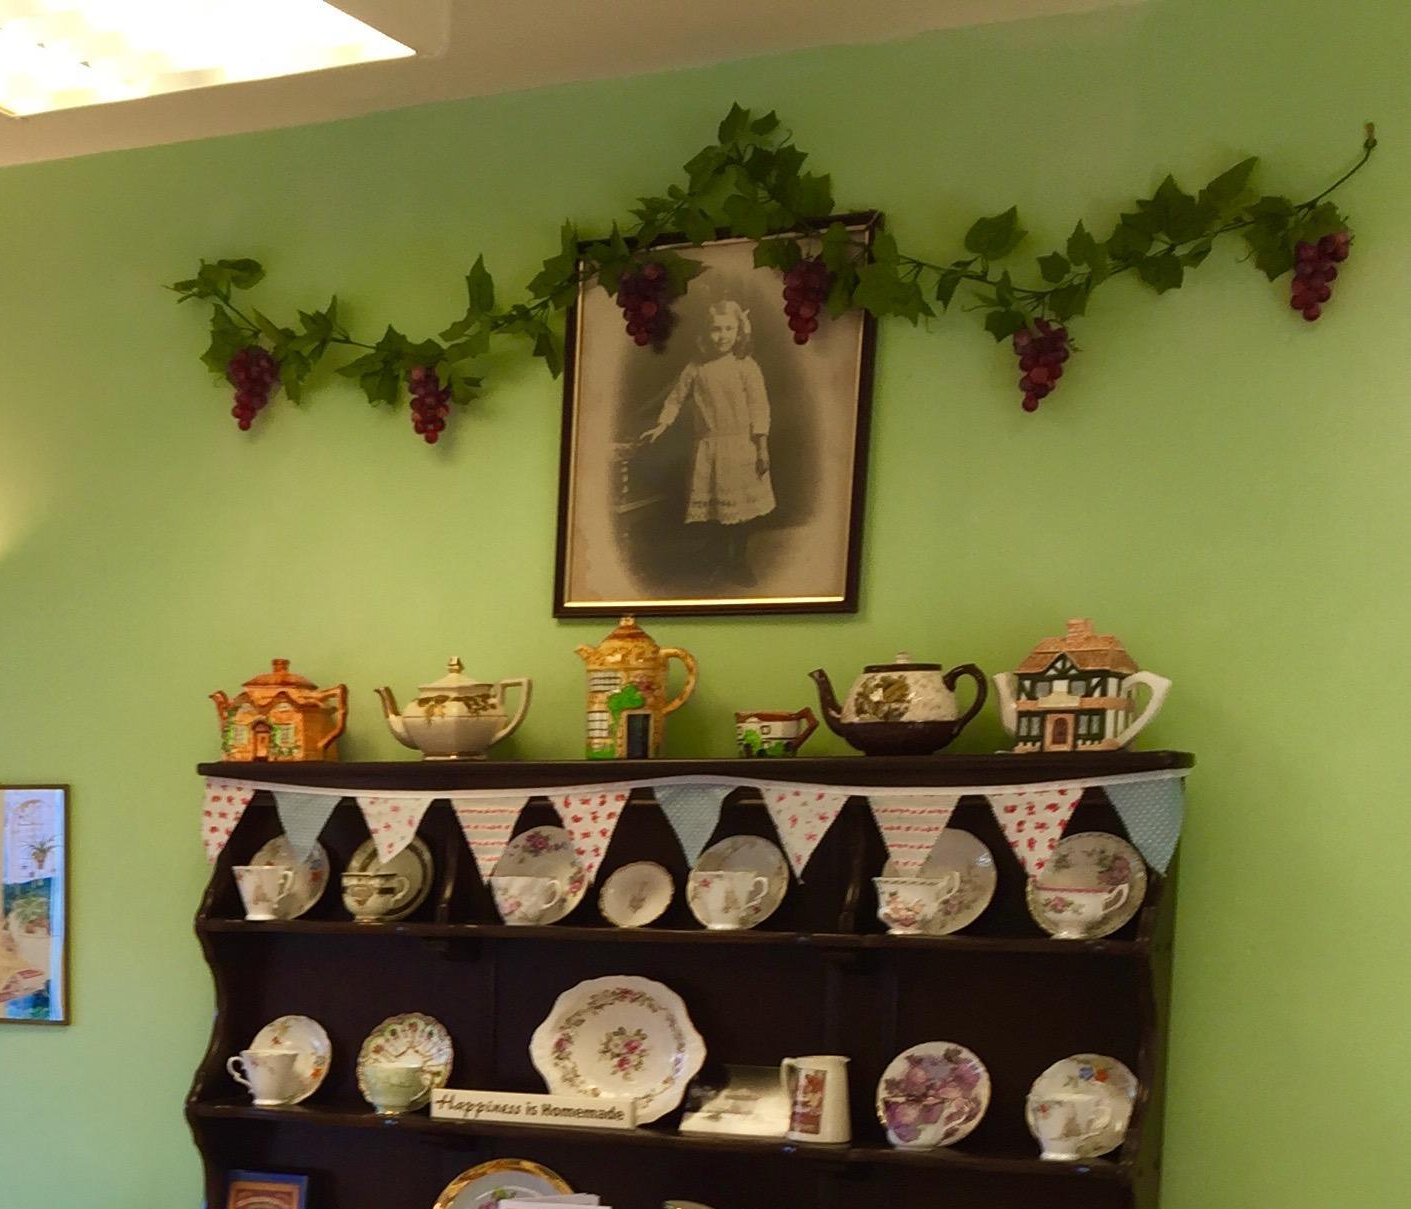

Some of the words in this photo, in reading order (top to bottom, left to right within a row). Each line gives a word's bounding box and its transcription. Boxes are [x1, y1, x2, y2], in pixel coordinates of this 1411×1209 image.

[435, 1093, 522, 1118] Happiness
[525, 1101, 538, 1116] is
[541, 1103, 625, 1121] Homemade
